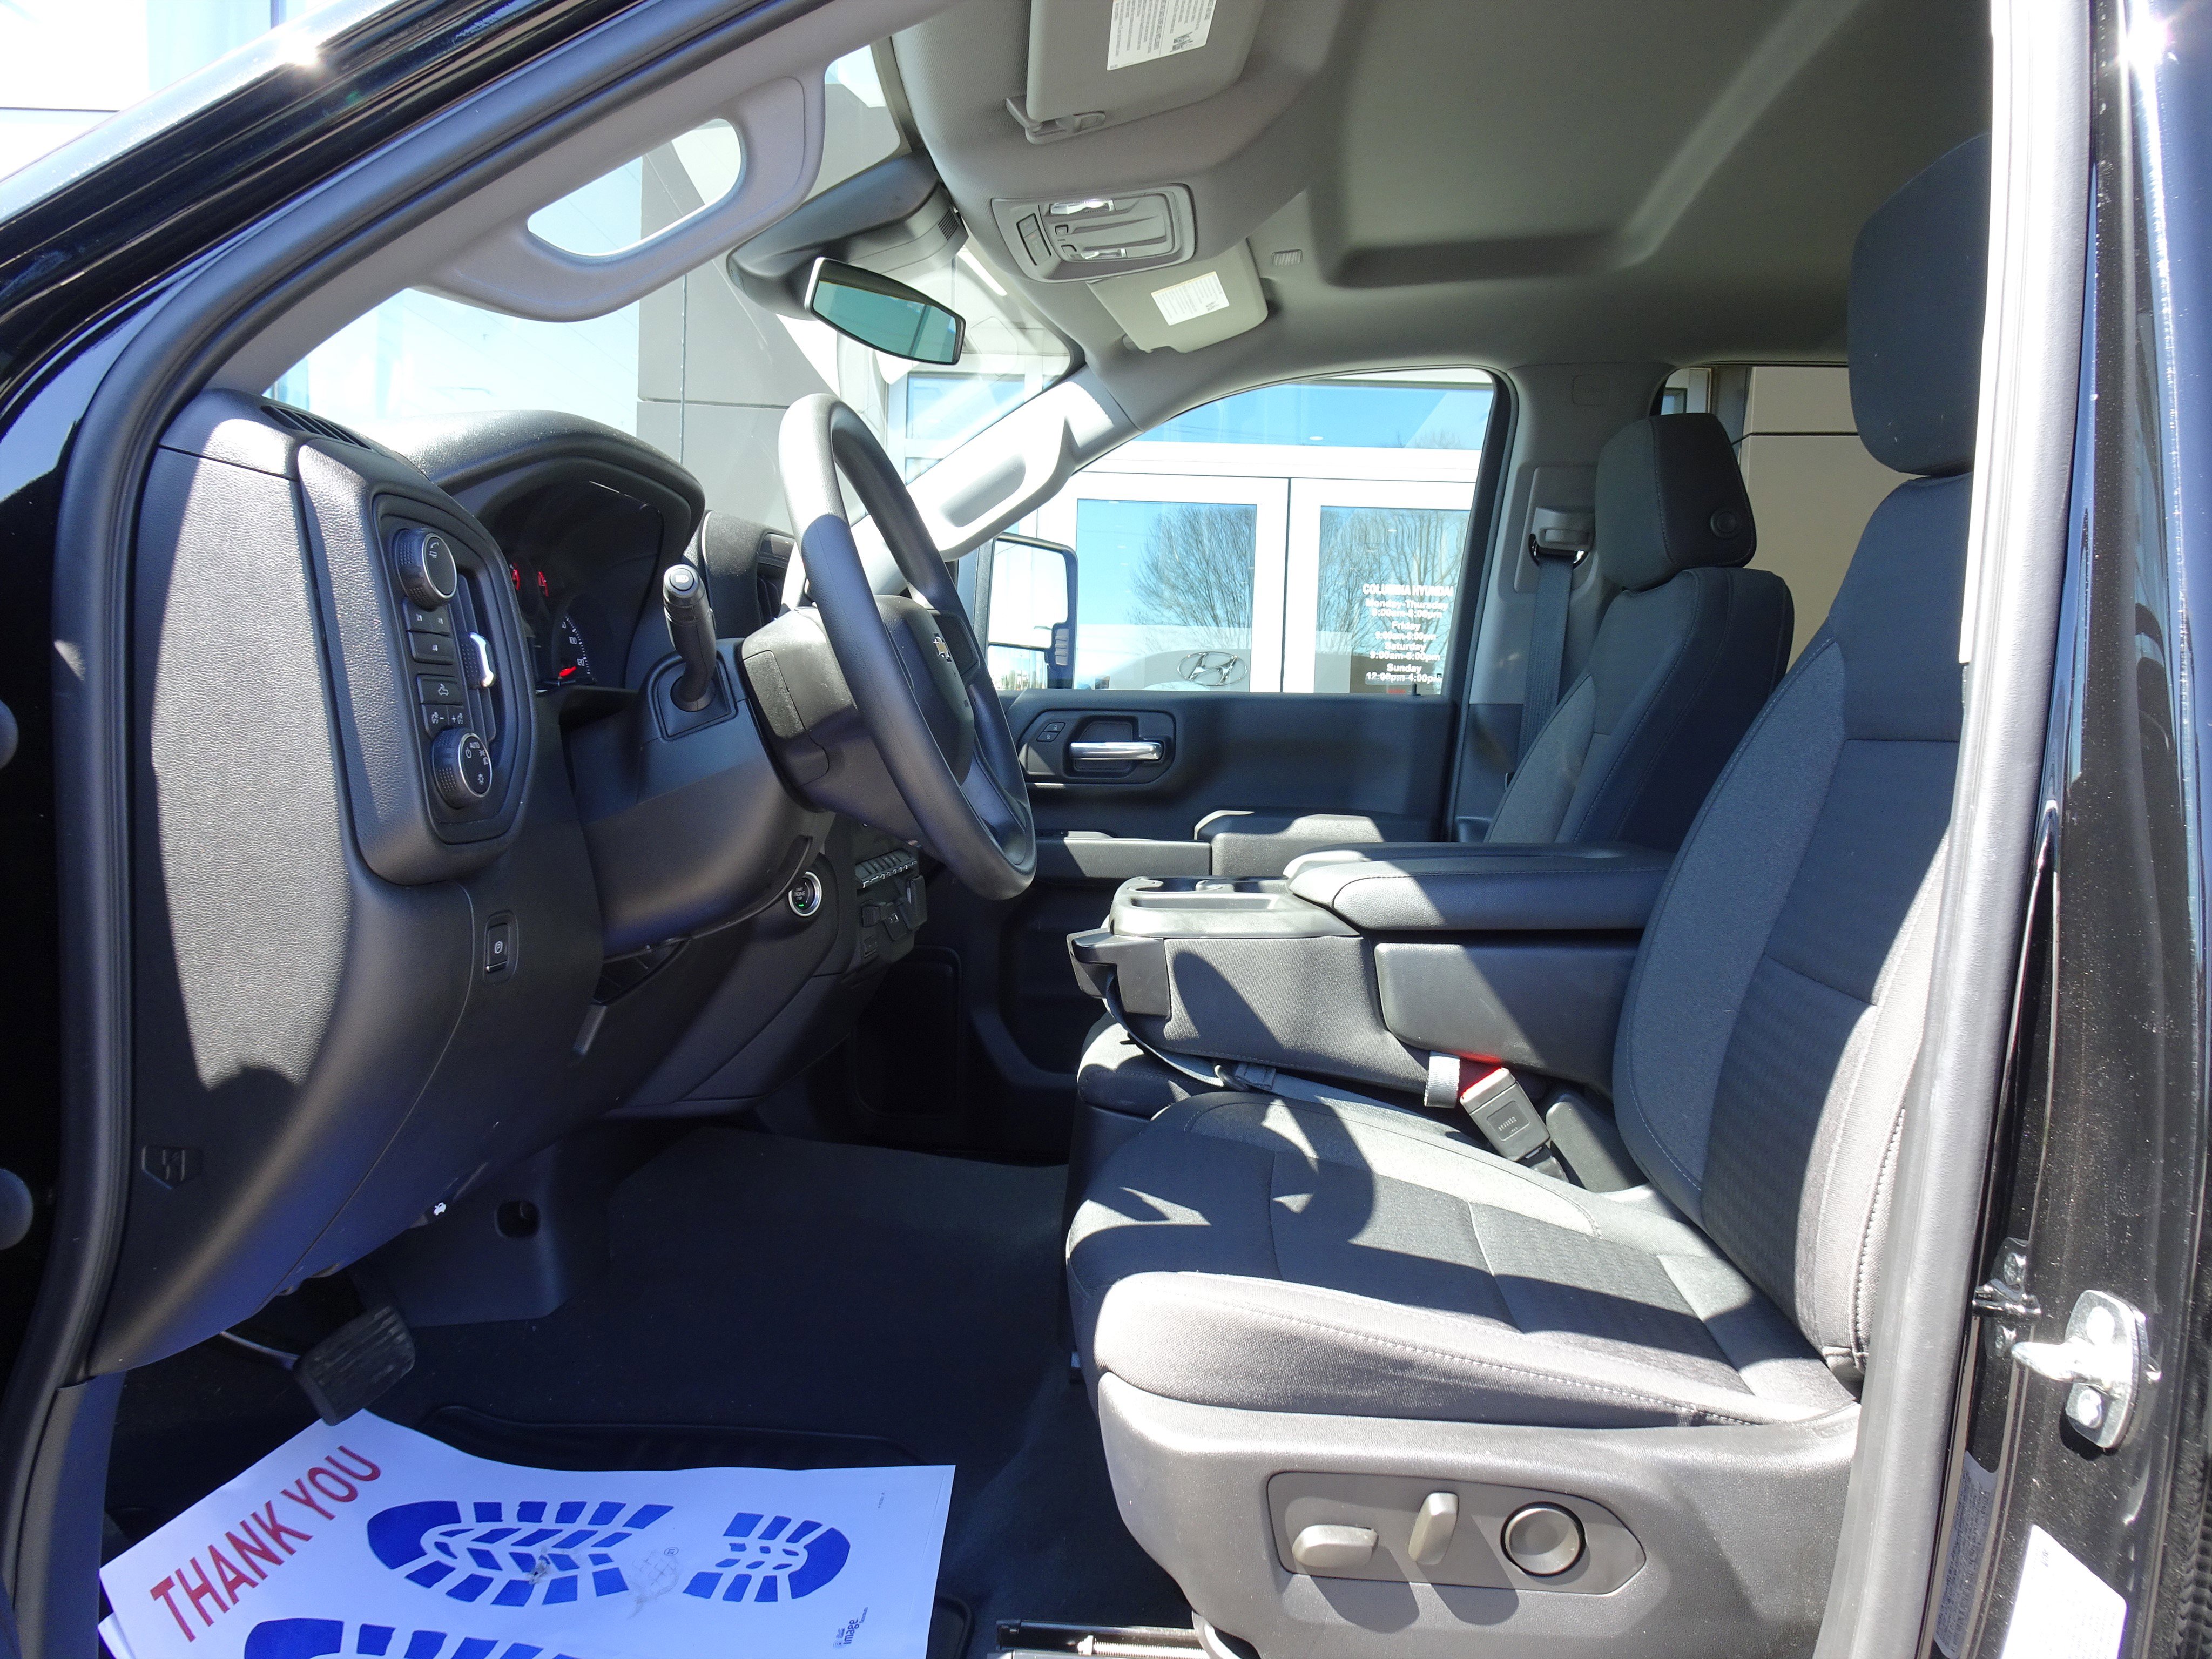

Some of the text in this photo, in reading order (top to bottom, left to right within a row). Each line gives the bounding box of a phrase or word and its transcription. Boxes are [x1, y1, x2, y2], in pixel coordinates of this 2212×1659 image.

[1412, 585, 1453, 596] HYUNDAI
[1391, 621, 1421, 631] Friday
[1384, 642, 1426, 651] Saturday
[1386, 663, 1422, 673] Sunday
[150, 1445, 381, 1642] THANK YOU
